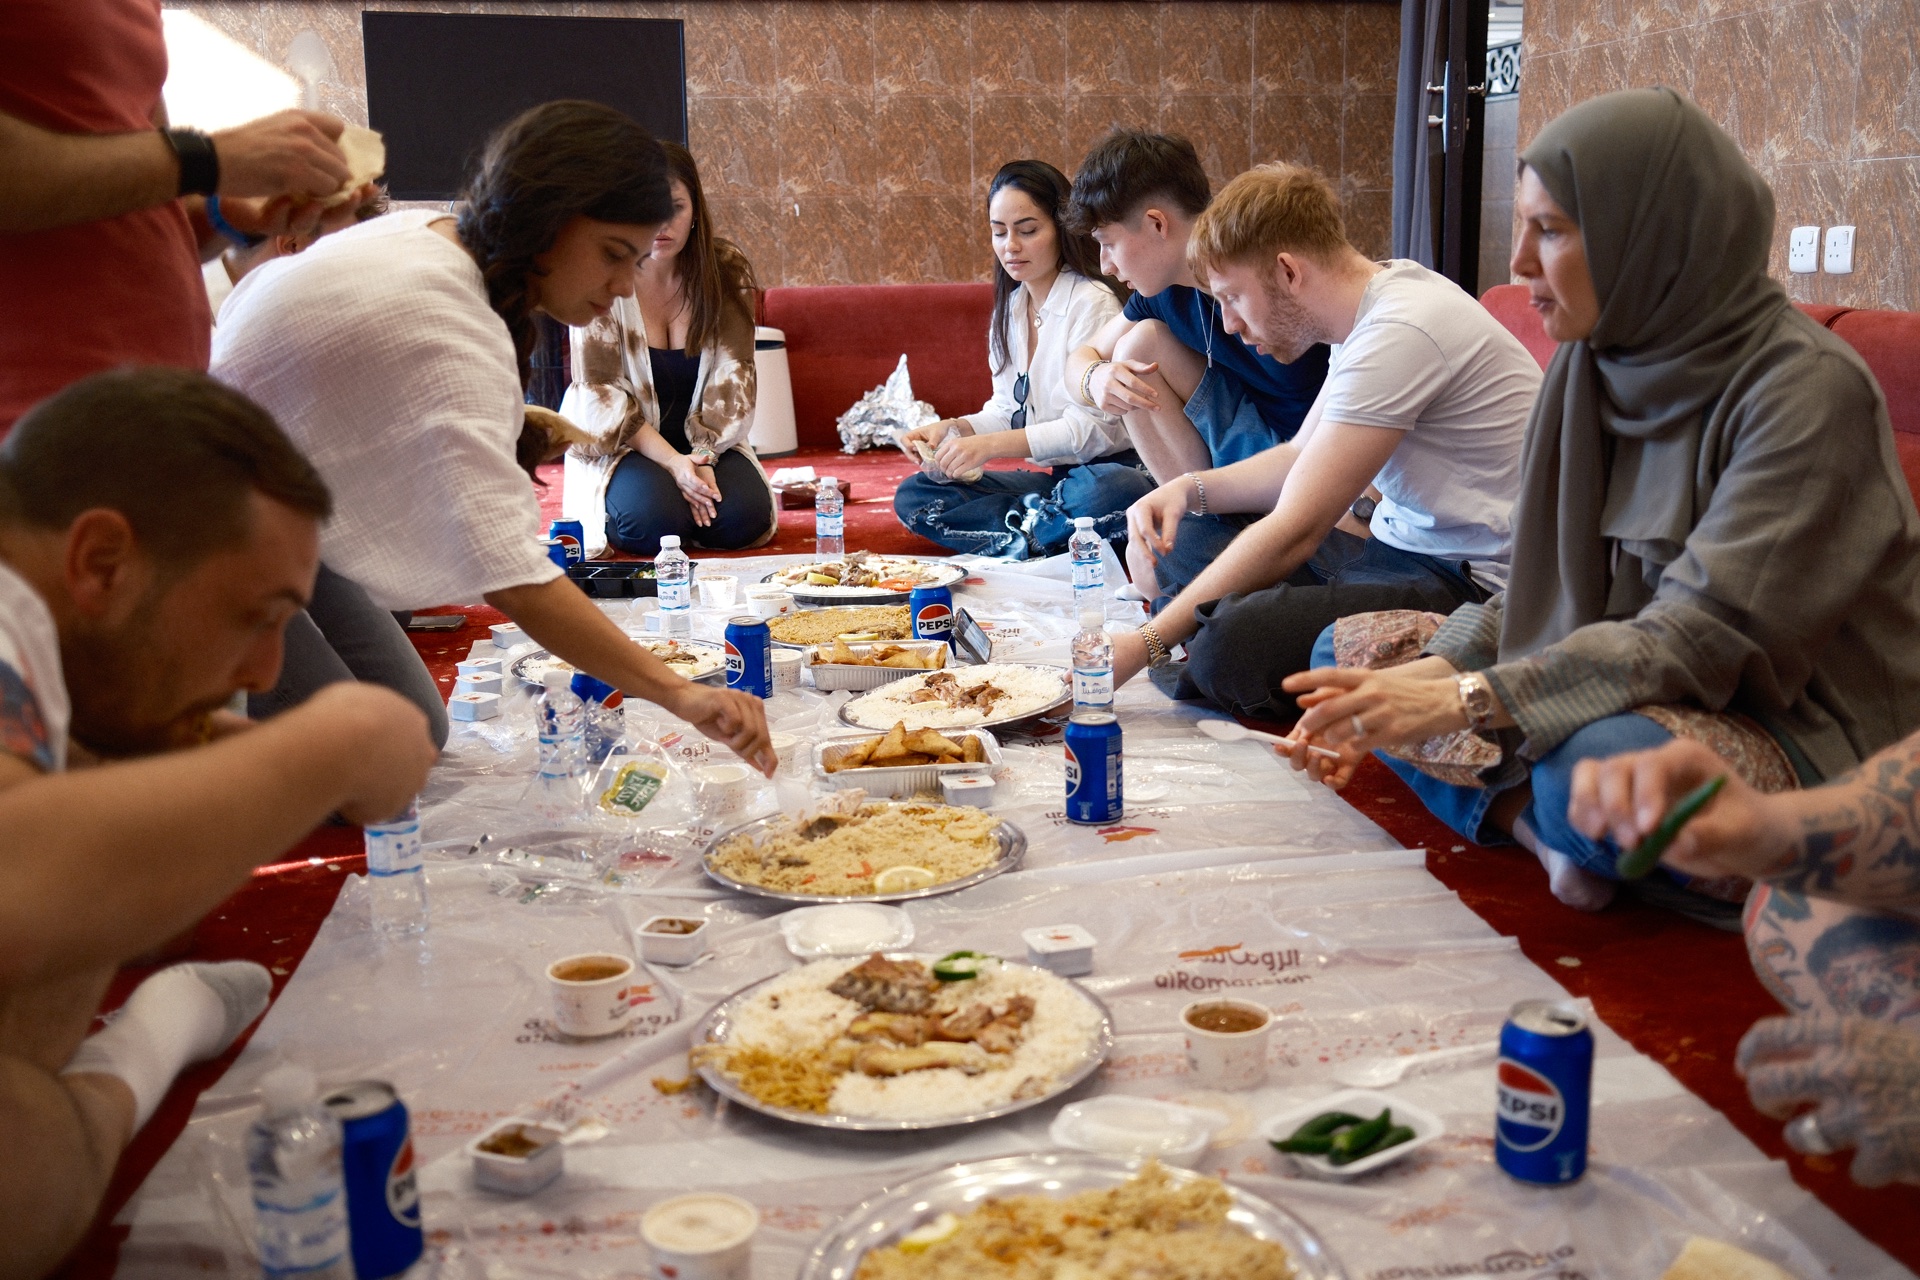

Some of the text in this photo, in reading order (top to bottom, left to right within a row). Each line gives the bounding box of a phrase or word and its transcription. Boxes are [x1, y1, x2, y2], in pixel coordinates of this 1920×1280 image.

[565, 547, 580, 556] PSI
[726, 657, 742, 670] PSI
[1500, 1090, 1557, 1122] EPSI
